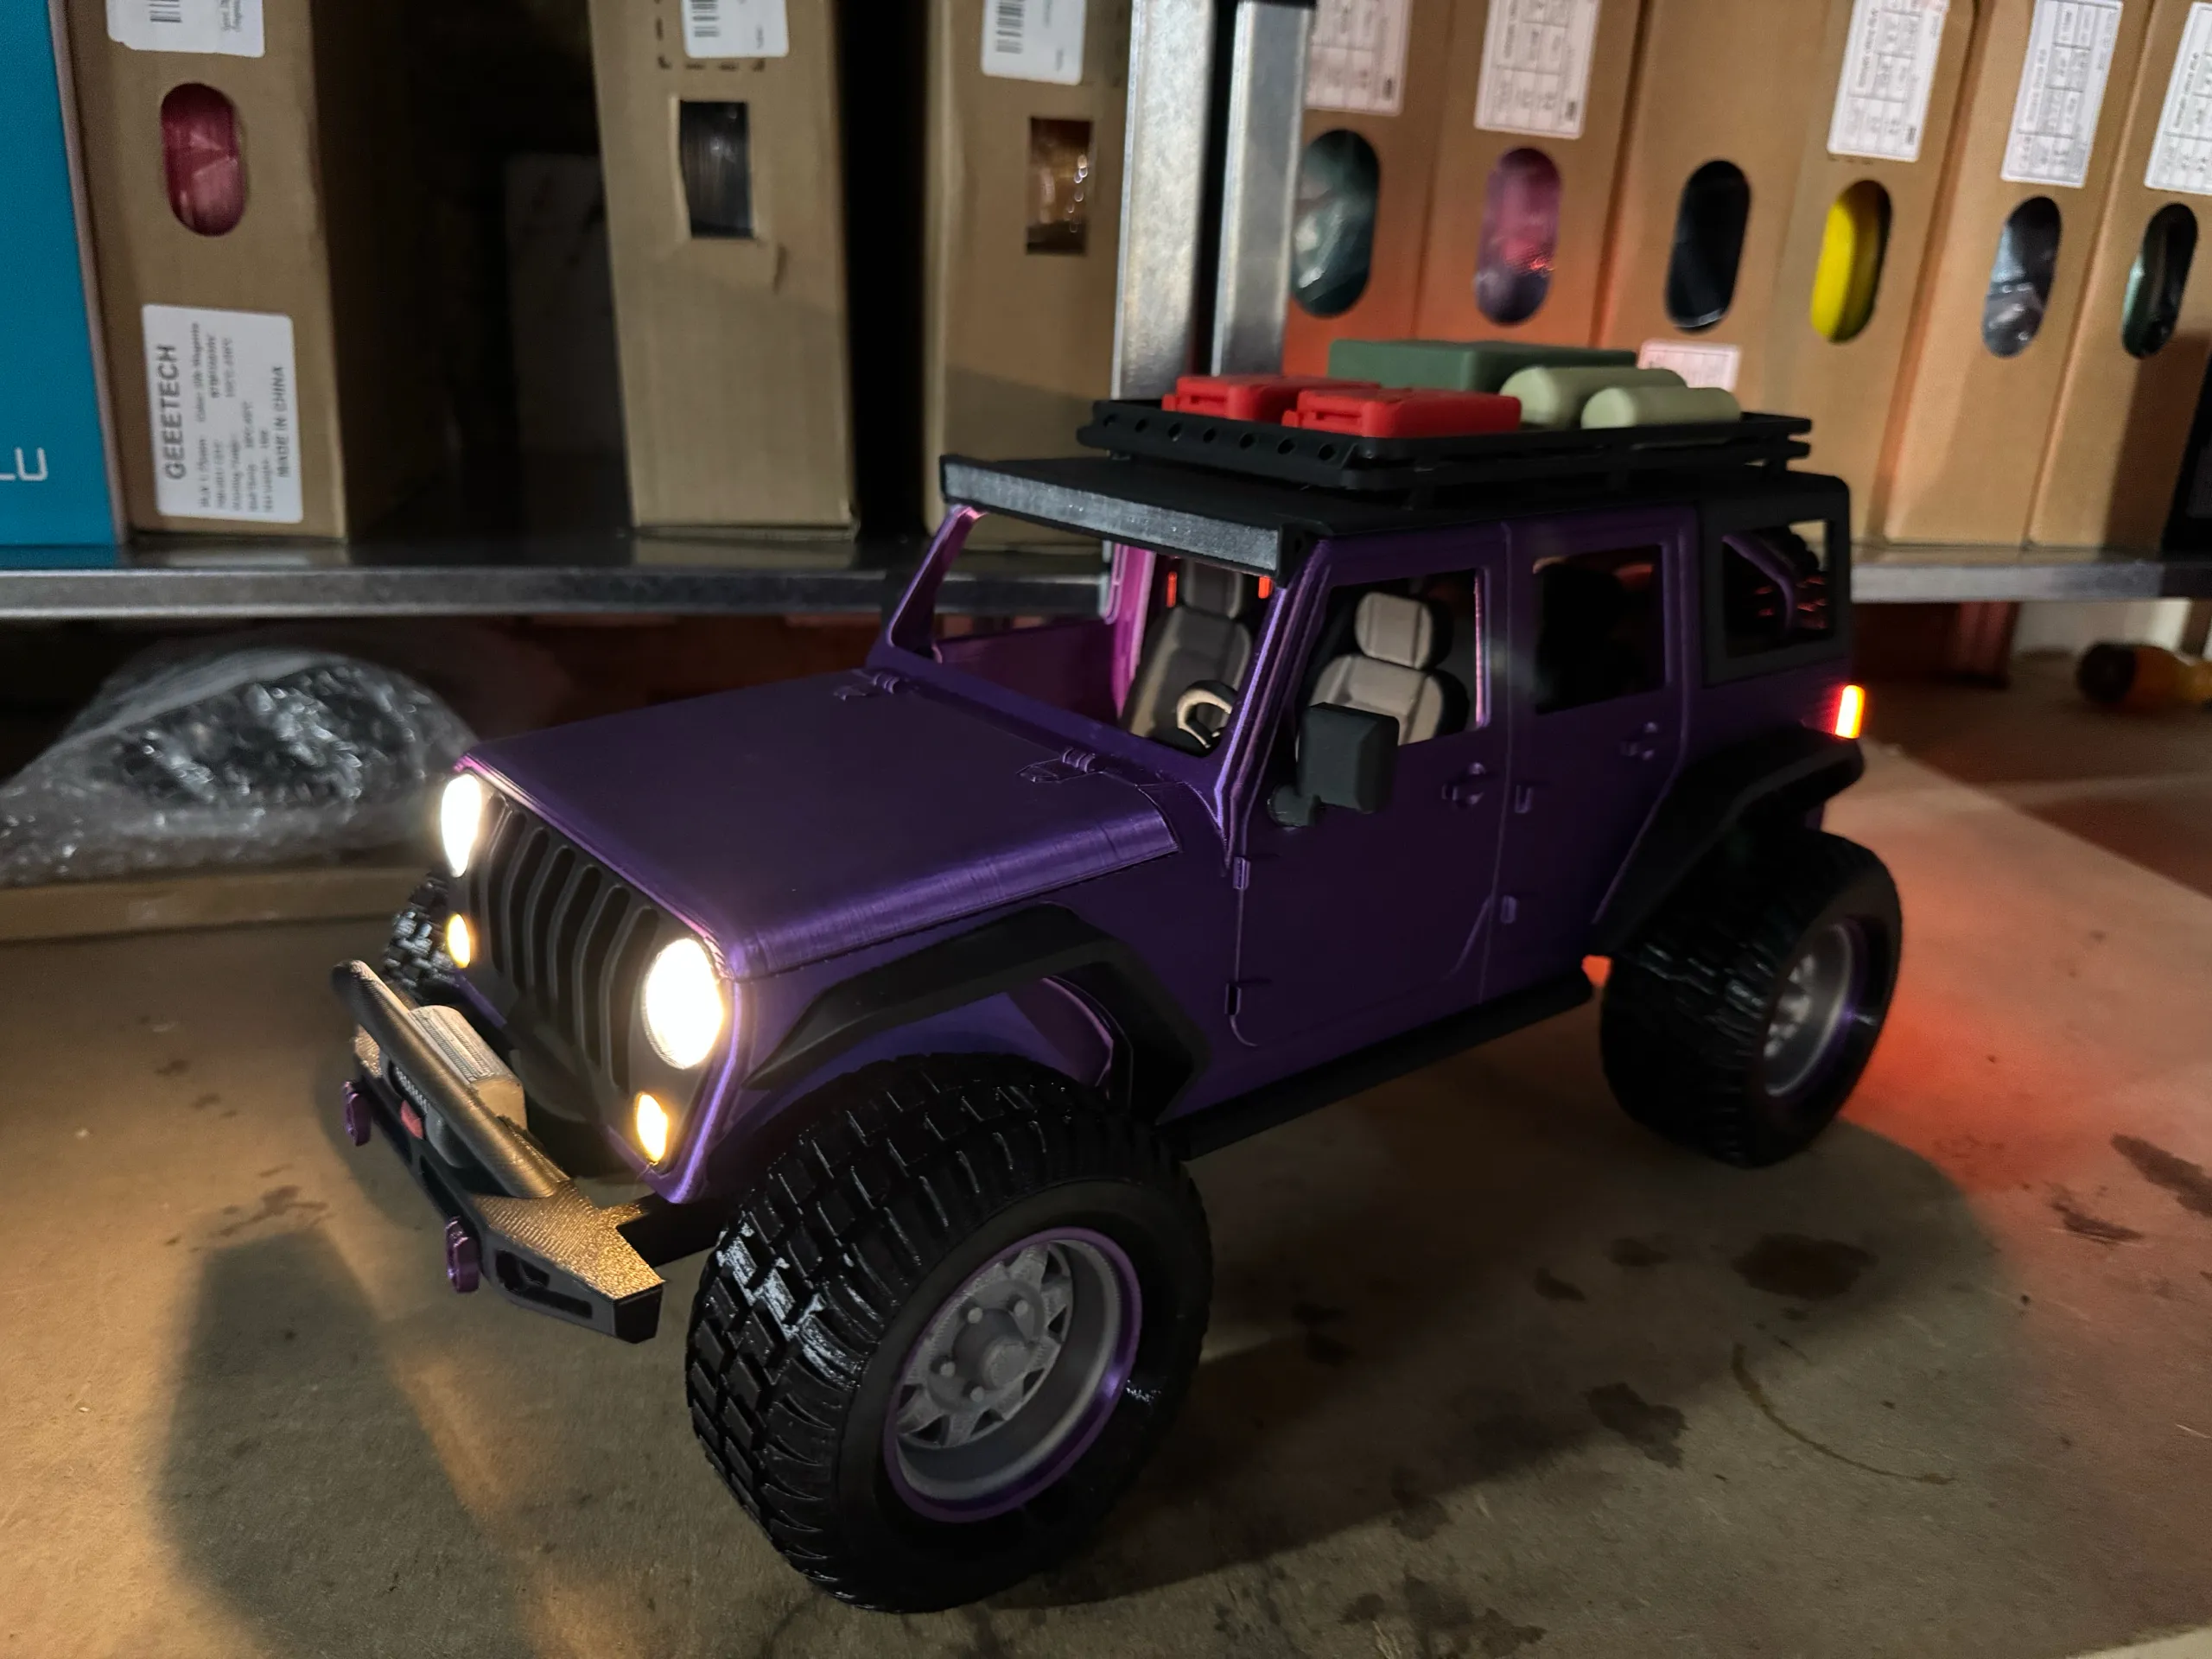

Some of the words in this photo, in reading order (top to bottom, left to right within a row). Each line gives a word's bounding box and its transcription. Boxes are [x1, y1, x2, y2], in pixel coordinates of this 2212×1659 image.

[271, 365, 288, 412] CHINA
[156, 343, 187, 480] GEEETECH
[273, 416, 288, 431] IN
[276, 435, 290, 477] MADE
